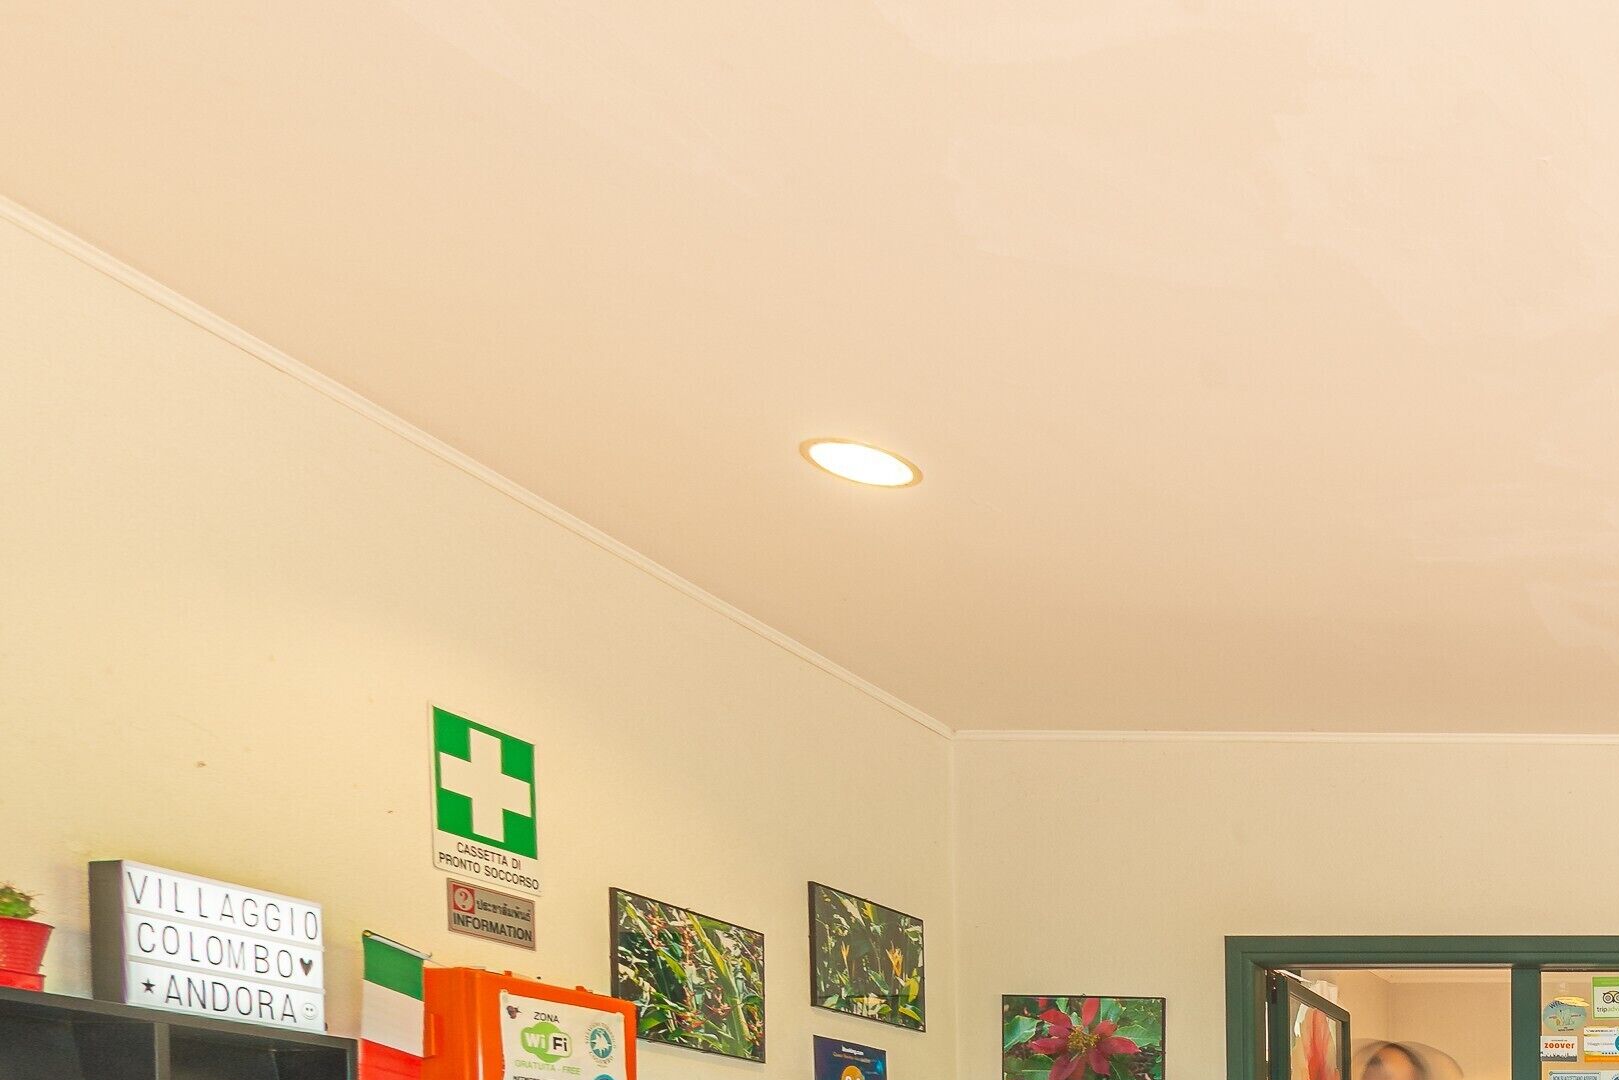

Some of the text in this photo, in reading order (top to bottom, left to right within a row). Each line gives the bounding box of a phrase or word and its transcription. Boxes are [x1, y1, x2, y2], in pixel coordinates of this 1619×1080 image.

[439, 852, 540, 890] PRONTO SOCCORSO
[457, 842, 521, 870] CASSETTA DI
[127, 871, 318, 940] VILLAGGIO
[453, 912, 533, 941] INFORMATION
[137, 922, 293, 978] COLOMBO
[165, 974, 297, 1023] ANDORA
[534, 1011, 560, 1023] ZONA
